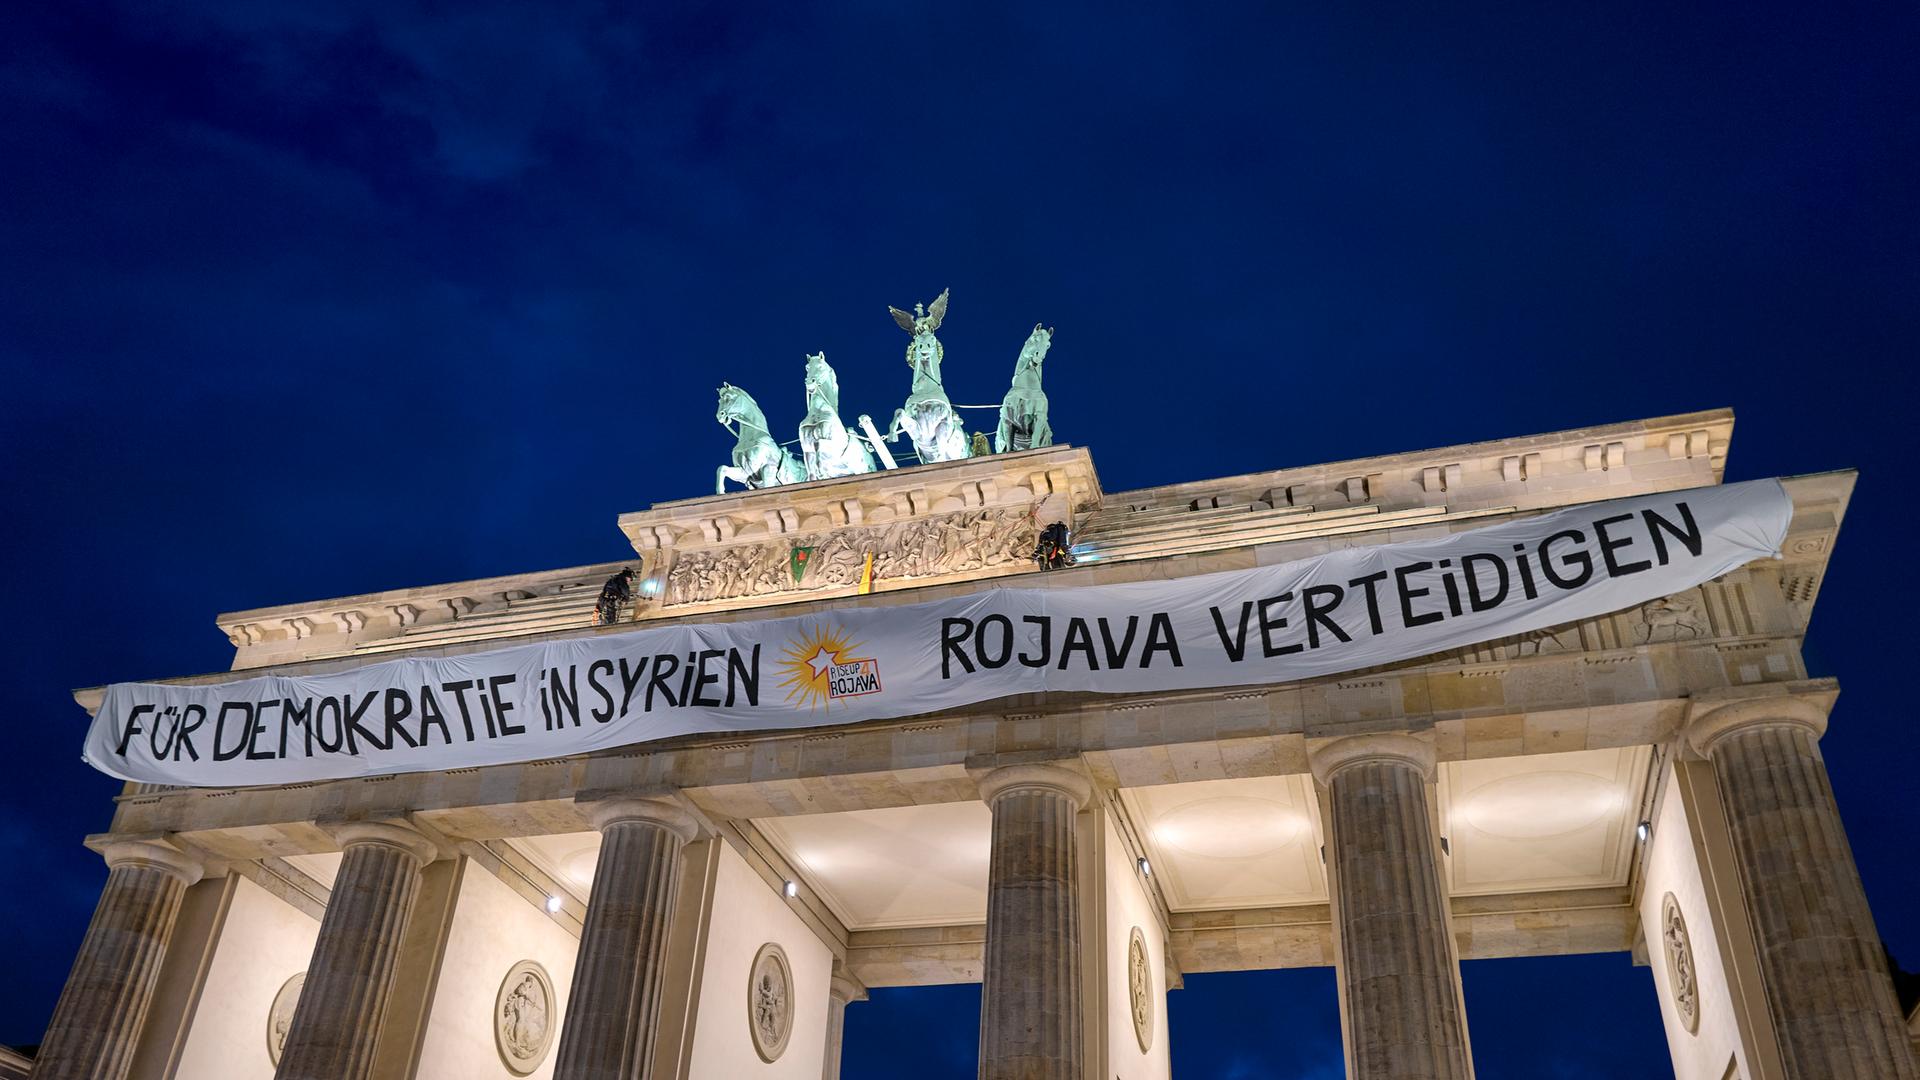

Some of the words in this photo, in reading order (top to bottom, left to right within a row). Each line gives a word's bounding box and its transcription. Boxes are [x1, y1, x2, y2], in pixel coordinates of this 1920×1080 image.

[941, 612, 1184, 679] ROJAVA
[830, 673, 879, 696] ROJAVA
[116, 703, 207, 762] FÜR
